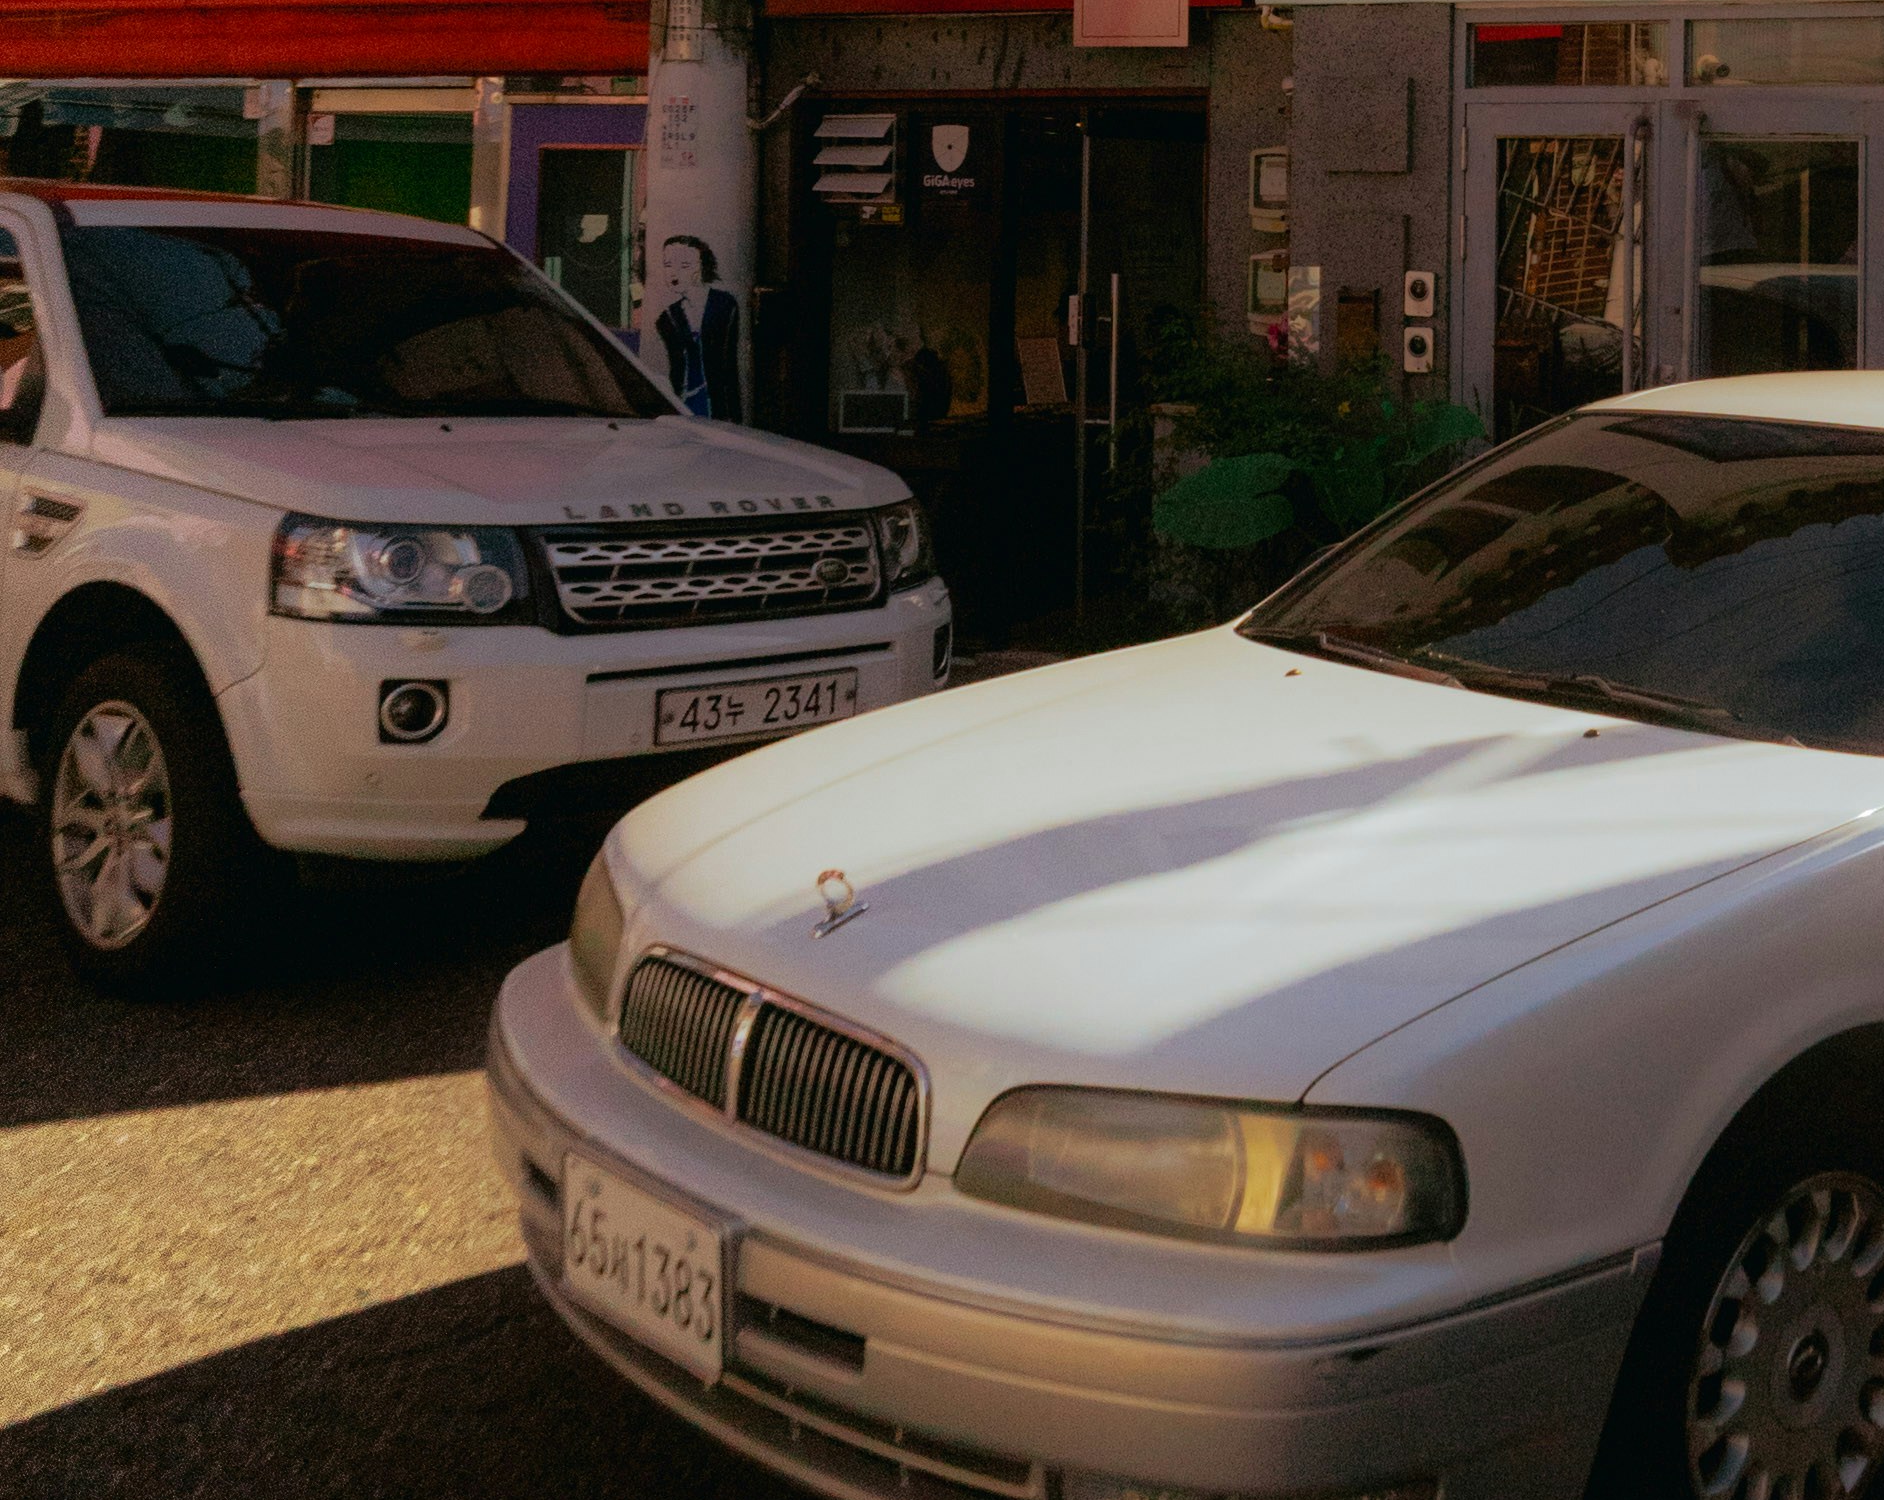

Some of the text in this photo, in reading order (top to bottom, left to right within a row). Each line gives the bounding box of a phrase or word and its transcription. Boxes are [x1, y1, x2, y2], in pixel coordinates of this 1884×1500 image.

[563, 495, 835, 520] LAND ROVER
[679, 679, 838, 732] 43누 2341
